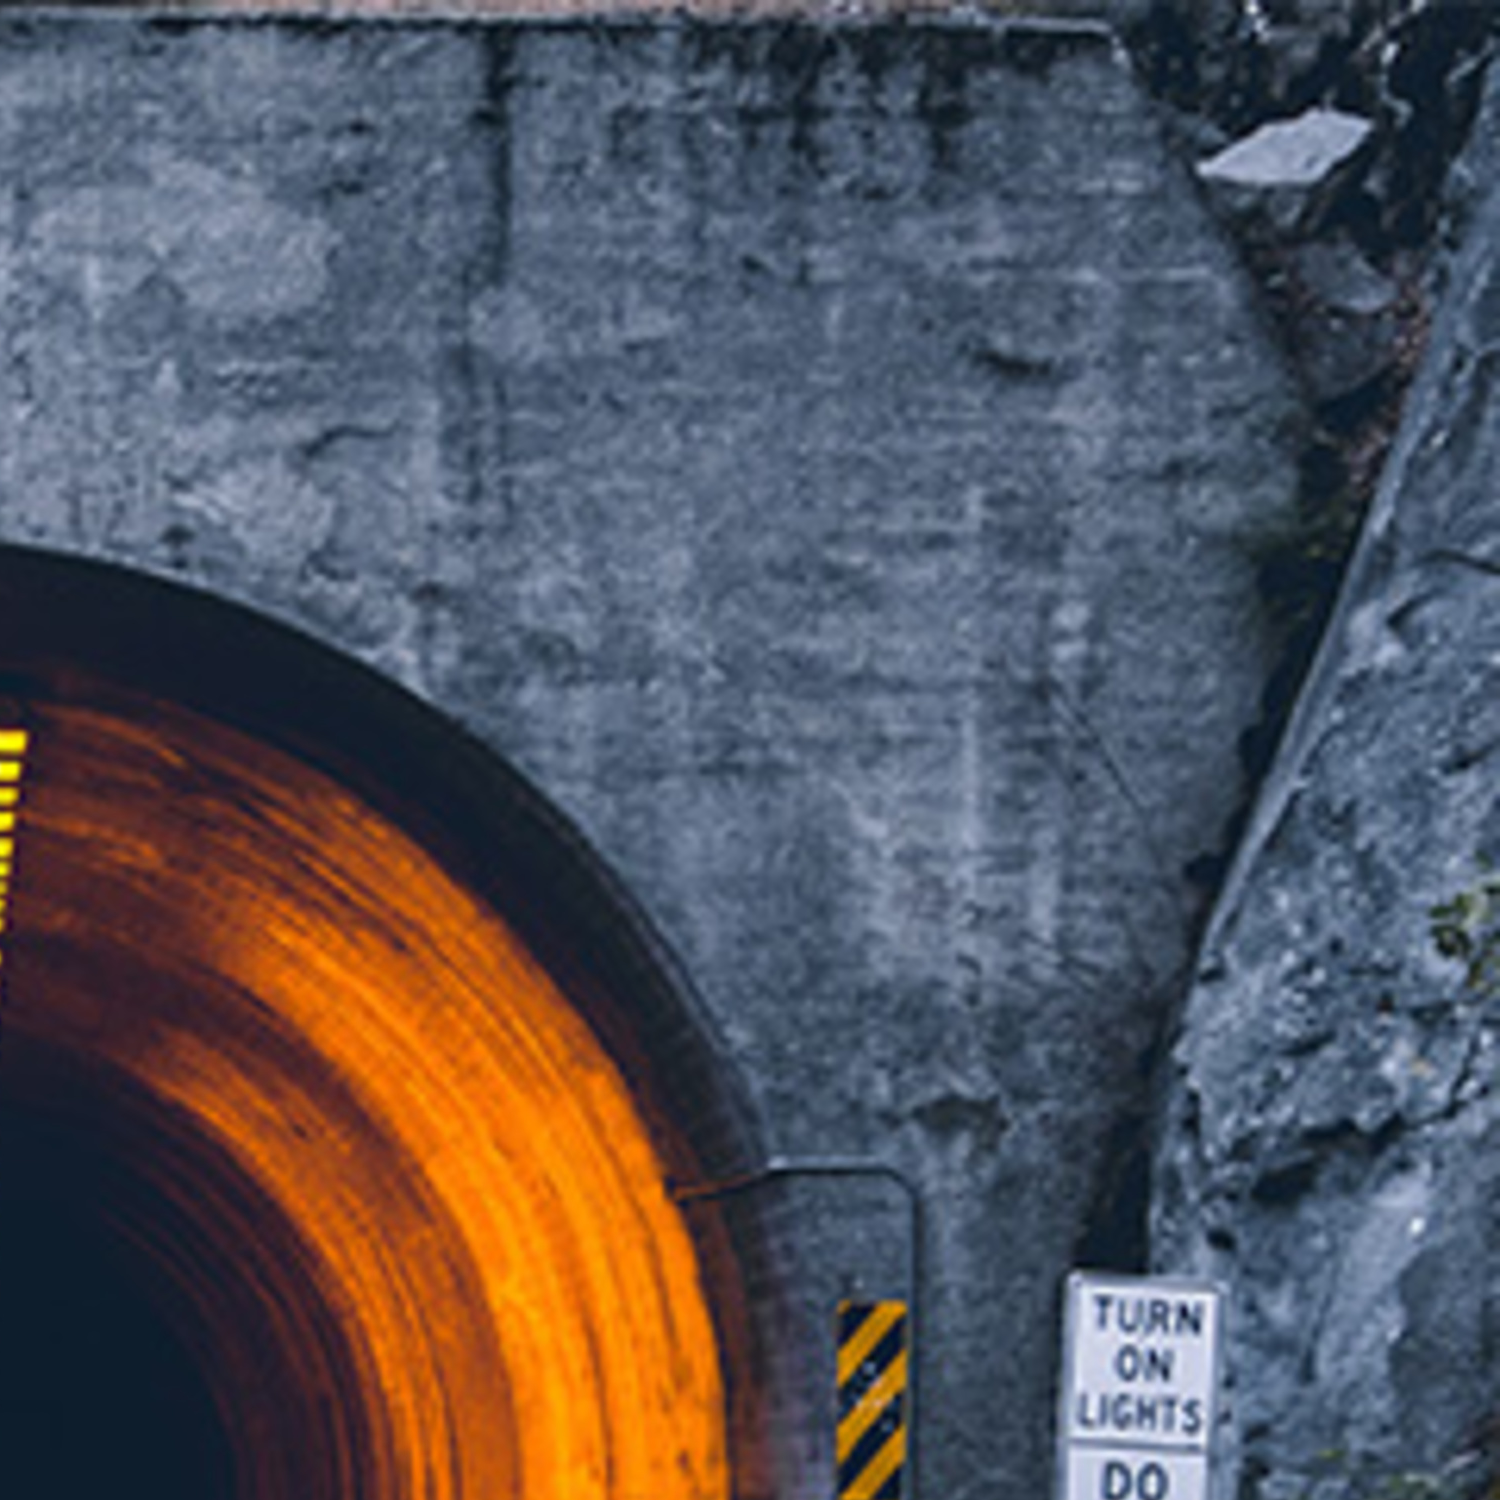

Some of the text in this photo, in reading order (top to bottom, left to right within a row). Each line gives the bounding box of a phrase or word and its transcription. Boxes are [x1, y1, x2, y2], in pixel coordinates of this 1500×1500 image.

[1093, 1295, 1203, 1335] TURN
[1116, 1345, 1174, 1382] ON
[1077, 1393, 1202, 1436] LIGHTS
